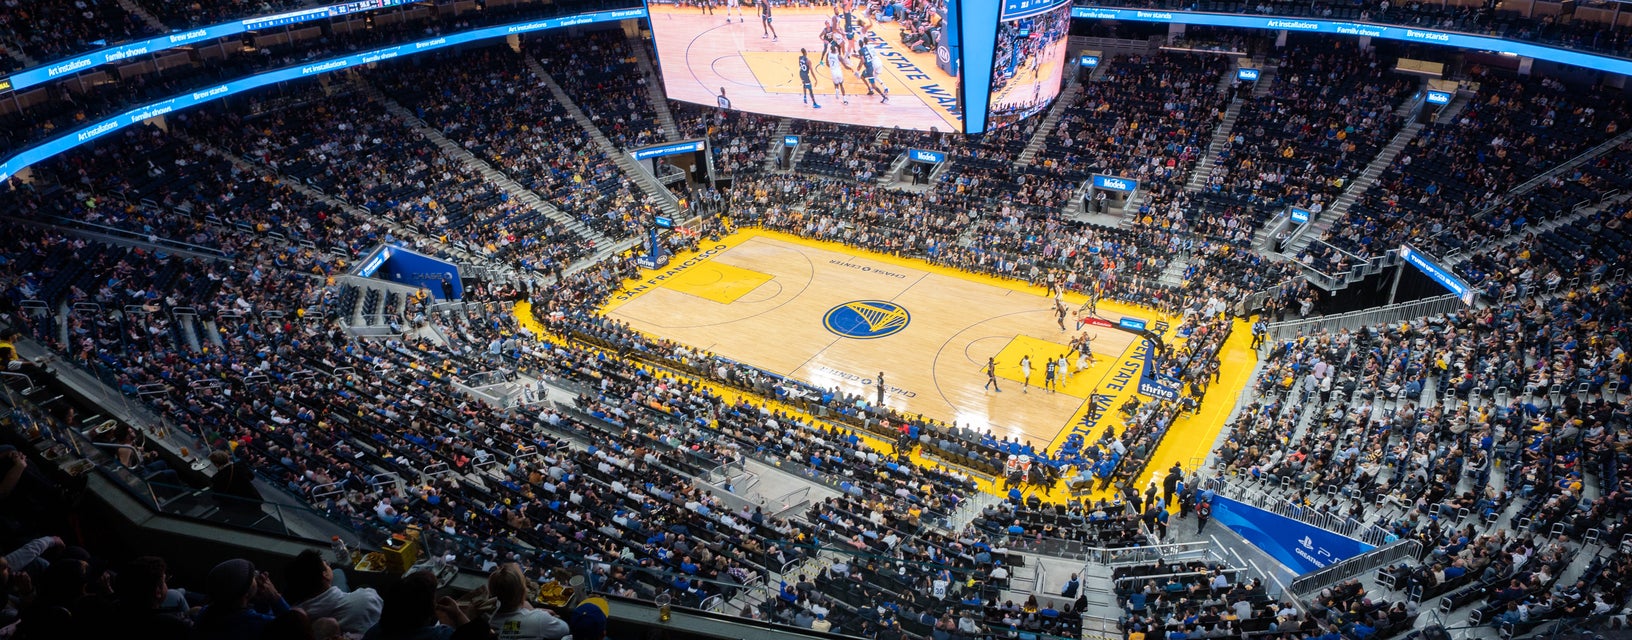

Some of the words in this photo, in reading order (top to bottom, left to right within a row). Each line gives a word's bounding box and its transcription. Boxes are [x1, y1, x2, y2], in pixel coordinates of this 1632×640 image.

[518, 22, 547, 31] installations
[1279, 21, 1318, 29] installations
[170, 34, 186, 43] Brew
[187, 29, 207, 39] stands
[1337, 26, 1359, 35] Family
[1359, 29, 1380, 37] shows
[1406, 30, 1425, 39] Brew
[1425, 32, 1449, 41] stands
[105, 51, 125, 62] Family
[126, 47, 147, 57] shows
[48, 68, 58, 77] Art
[58, 58, 91, 73] installations
[313, 60, 347, 72] installations
[880, 51, 932, 80] STATE
[193, 92, 209, 100] Brew
[209, 85, 228, 96] stands
[1428, 93, 1448, 102] Modelo
[131, 112, 151, 123] Family
[151, 105, 172, 116] shows
[78, 133, 88, 141] Art
[87, 120, 118, 138] installations
[917, 151, 936, 161] Modelo
[1104, 178, 1126, 190] Modelo
[1292, 211, 1309, 221] Modelo
[637, 257, 655, 267] thrive
[829, 259, 861, 270] CENTER
[617, 285, 649, 301] SAN
[648, 244, 727, 284] FRANCISCO
[872, 269, 906, 279] CHASE
[820, 366, 860, 381] CENT
[1106, 361, 1140, 391] STATE
[1141, 383, 1173, 398] thrive
